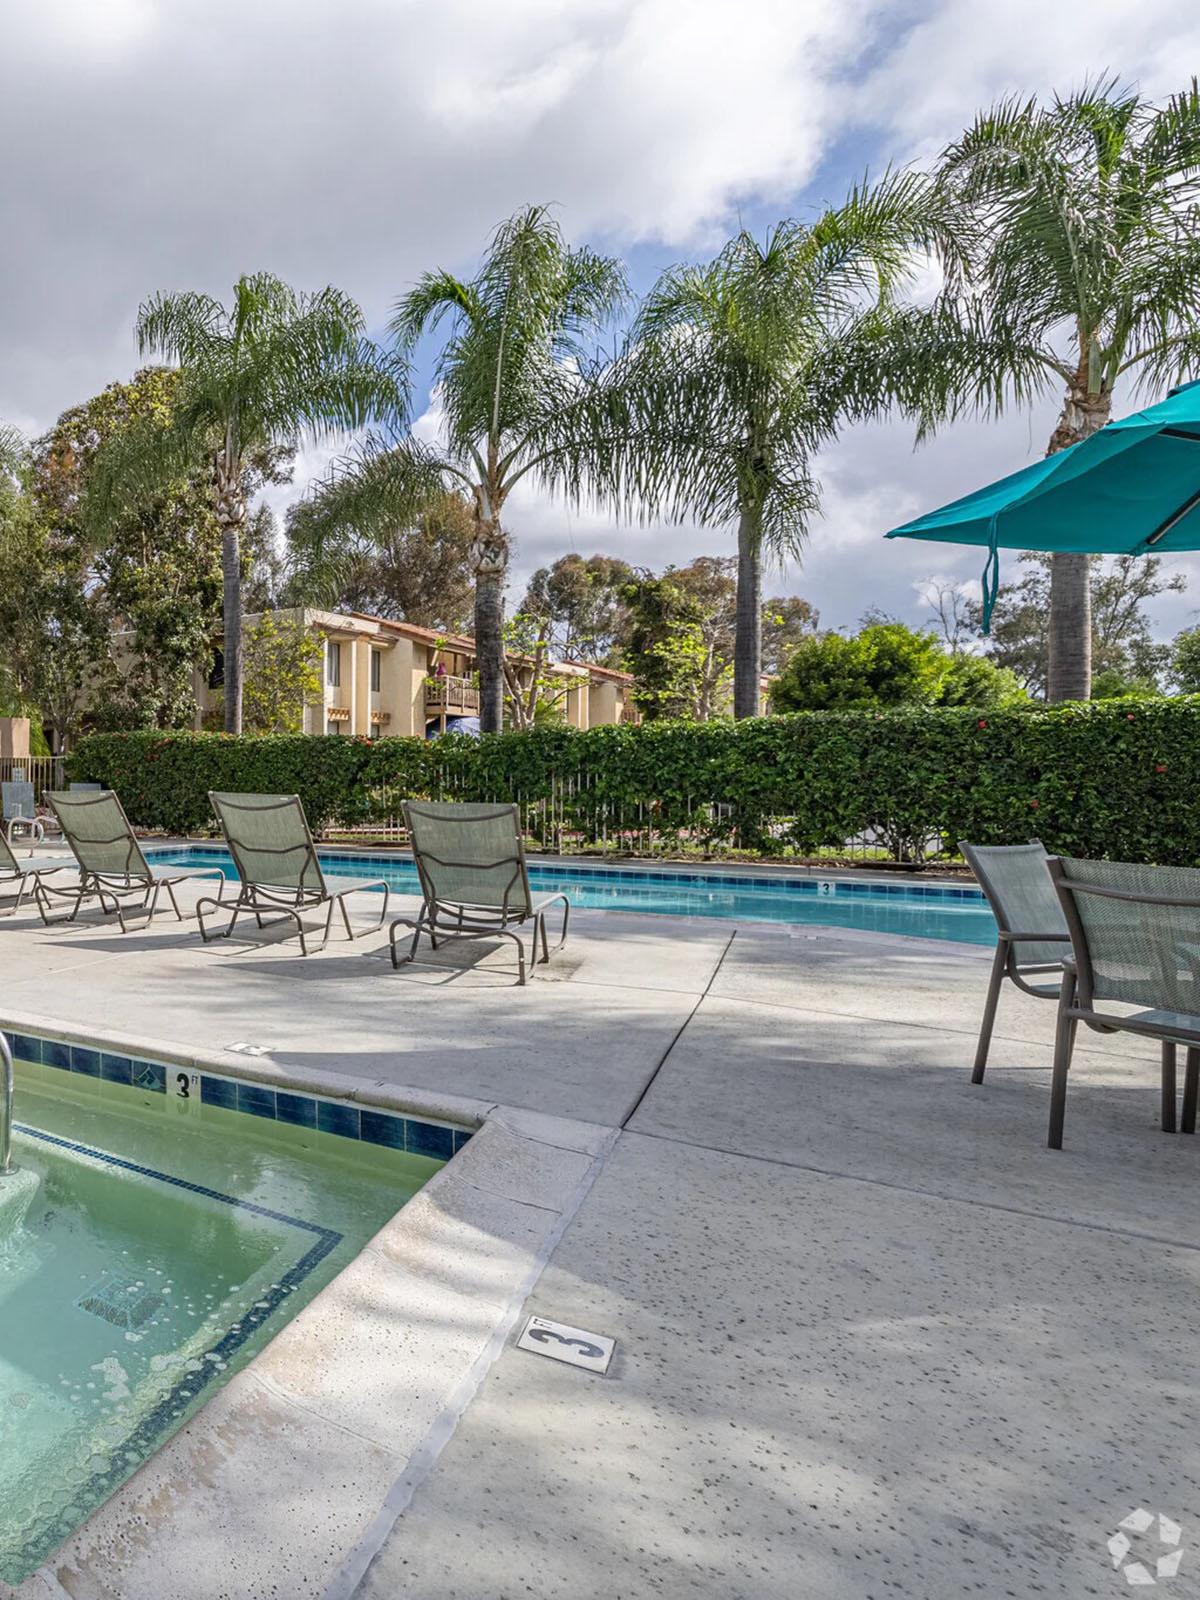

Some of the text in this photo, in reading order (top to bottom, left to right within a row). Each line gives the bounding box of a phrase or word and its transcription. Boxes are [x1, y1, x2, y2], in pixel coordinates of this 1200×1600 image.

[822, 883, 830, 895] 3
[176, 1073, 198, 1098] 3 FT
[528, 1318, 605, 1358] 3 FT
